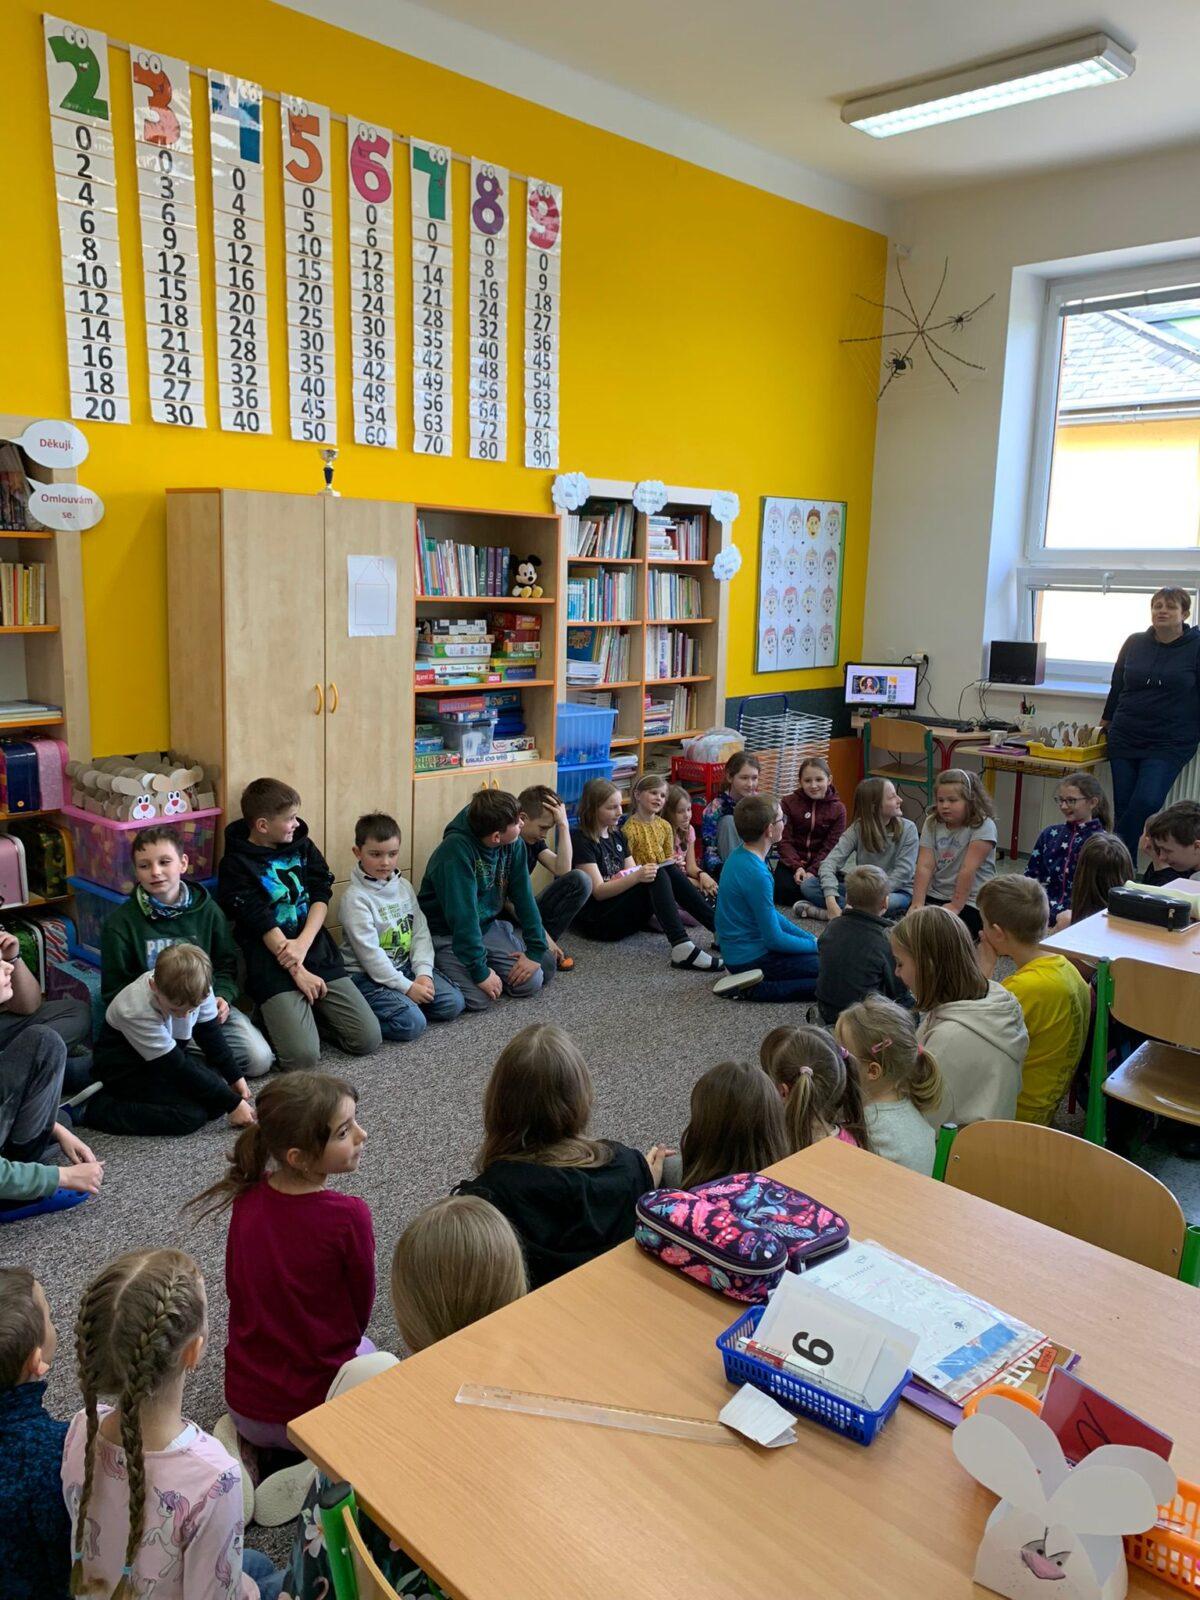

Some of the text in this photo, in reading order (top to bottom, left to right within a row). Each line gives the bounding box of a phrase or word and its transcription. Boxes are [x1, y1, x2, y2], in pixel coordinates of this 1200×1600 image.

[48, 36, 109, 120] 2
[133, 61, 181, 146] 3
[76, 126, 91, 150] 0
[287, 109, 322, 184] 5
[77, 154, 92, 179] 2
[159, 149, 172, 174] 0
[350, 134, 391, 204] 6
[161, 176, 174, 199] 3
[233, 168, 245, 190] 0
[413, 147, 448, 220] 7
[79, 183, 94, 205] 4
[232, 194, 245, 215] 4
[303, 187, 314, 208] 0
[473, 172, 504, 235] 8
[81, 210, 94, 234] 6
[162, 203, 175, 226] 6
[304, 211, 314, 233] 5
[366, 205, 377, 225] 0
[528, 189, 559, 249] 9
[163, 227, 176, 249] 9
[234, 218, 246, 240] 8
[367, 228, 377, 248] 6
[428, 222, 437, 242] 0
[82, 237, 97, 260] 8
[228, 242, 253, 266] 12
[299, 234, 321, 257] 10
[428, 245, 437, 264] 7
[485, 238, 494, 257] 0
[159, 252, 186, 277] 12
[299, 258, 321, 281] 15
[362, 249, 383, 272] 12
[485, 260, 494, 277] 8
[540, 253, 548, 271] 0
[77, 262, 107, 289] 10
[229, 267, 254, 290] 16
[363, 271, 383, 293] 18
[424, 265, 443, 286] 14
[539, 274, 547, 291] 9
[159, 277, 186, 301] 15
[299, 282, 322, 305] 20
[423, 287, 442, 307] 21
[480, 279, 498, 299] 16
[80, 290, 109, 316] 12
[230, 291, 254, 315] 20
[363, 294, 384, 315] 24
[479, 299, 498, 320] 24
[535, 293, 551, 312] 18
[160, 303, 188, 327] 18
[300, 306, 322, 328] 25
[424, 308, 443, 328] 28
[534, 313, 551, 332] 27
[82, 317, 111, 342] 14
[230, 316, 255, 339] 24
[363, 316, 385, 337] 30
[480, 319, 498, 339] 32
[161, 328, 189, 353] 21
[300, 330, 324, 352] 30
[363, 338, 385, 359] 36
[424, 329, 442, 349] 35
[534, 335, 551, 351] 36
[83, 344, 112, 369] 16
[231, 339, 256, 362] 28
[423, 350, 443, 370] 42
[479, 342, 498, 360] 40
[163, 354, 191, 378] 24
[301, 353, 323, 374] 35
[363, 361, 385, 381] 42
[479, 361, 498, 379] 48
[533, 352, 550, 371] 45
[85, 371, 114, 394] 18
[232, 363, 257, 386] 32
[423, 372, 443, 391] 49
[534, 372, 550, 390] 54
[164, 378, 190, 401] 27
[301, 376, 324, 397] 40
[363, 383, 385, 403] 48
[479, 380, 498, 400] 56
[233, 387, 258, 409] 36
[424, 394, 442, 412] 56
[534, 391, 550, 410] 63
[86, 397, 115, 421] 20
[163, 403, 193, 427] 30
[302, 399, 325, 419] 45
[365, 405, 386, 425] 54
[480, 403, 498, 420] 64
[233, 411, 259, 432] 40
[424, 413, 442, 433] 63
[480, 421, 497, 439] 72
[534, 411, 551, 429] 72
[303, 421, 325, 442] 50
[363, 426, 386, 447] 60
[534, 430, 549, 448] 81
[40, 438, 74, 451] Děkuji.
[424, 434, 443, 454] 70
[479, 441, 497, 459] 80
[534, 449, 551, 467] 90
[41, 493, 93, 504] Omlouvám
[62, 511, 76, 519] se.
